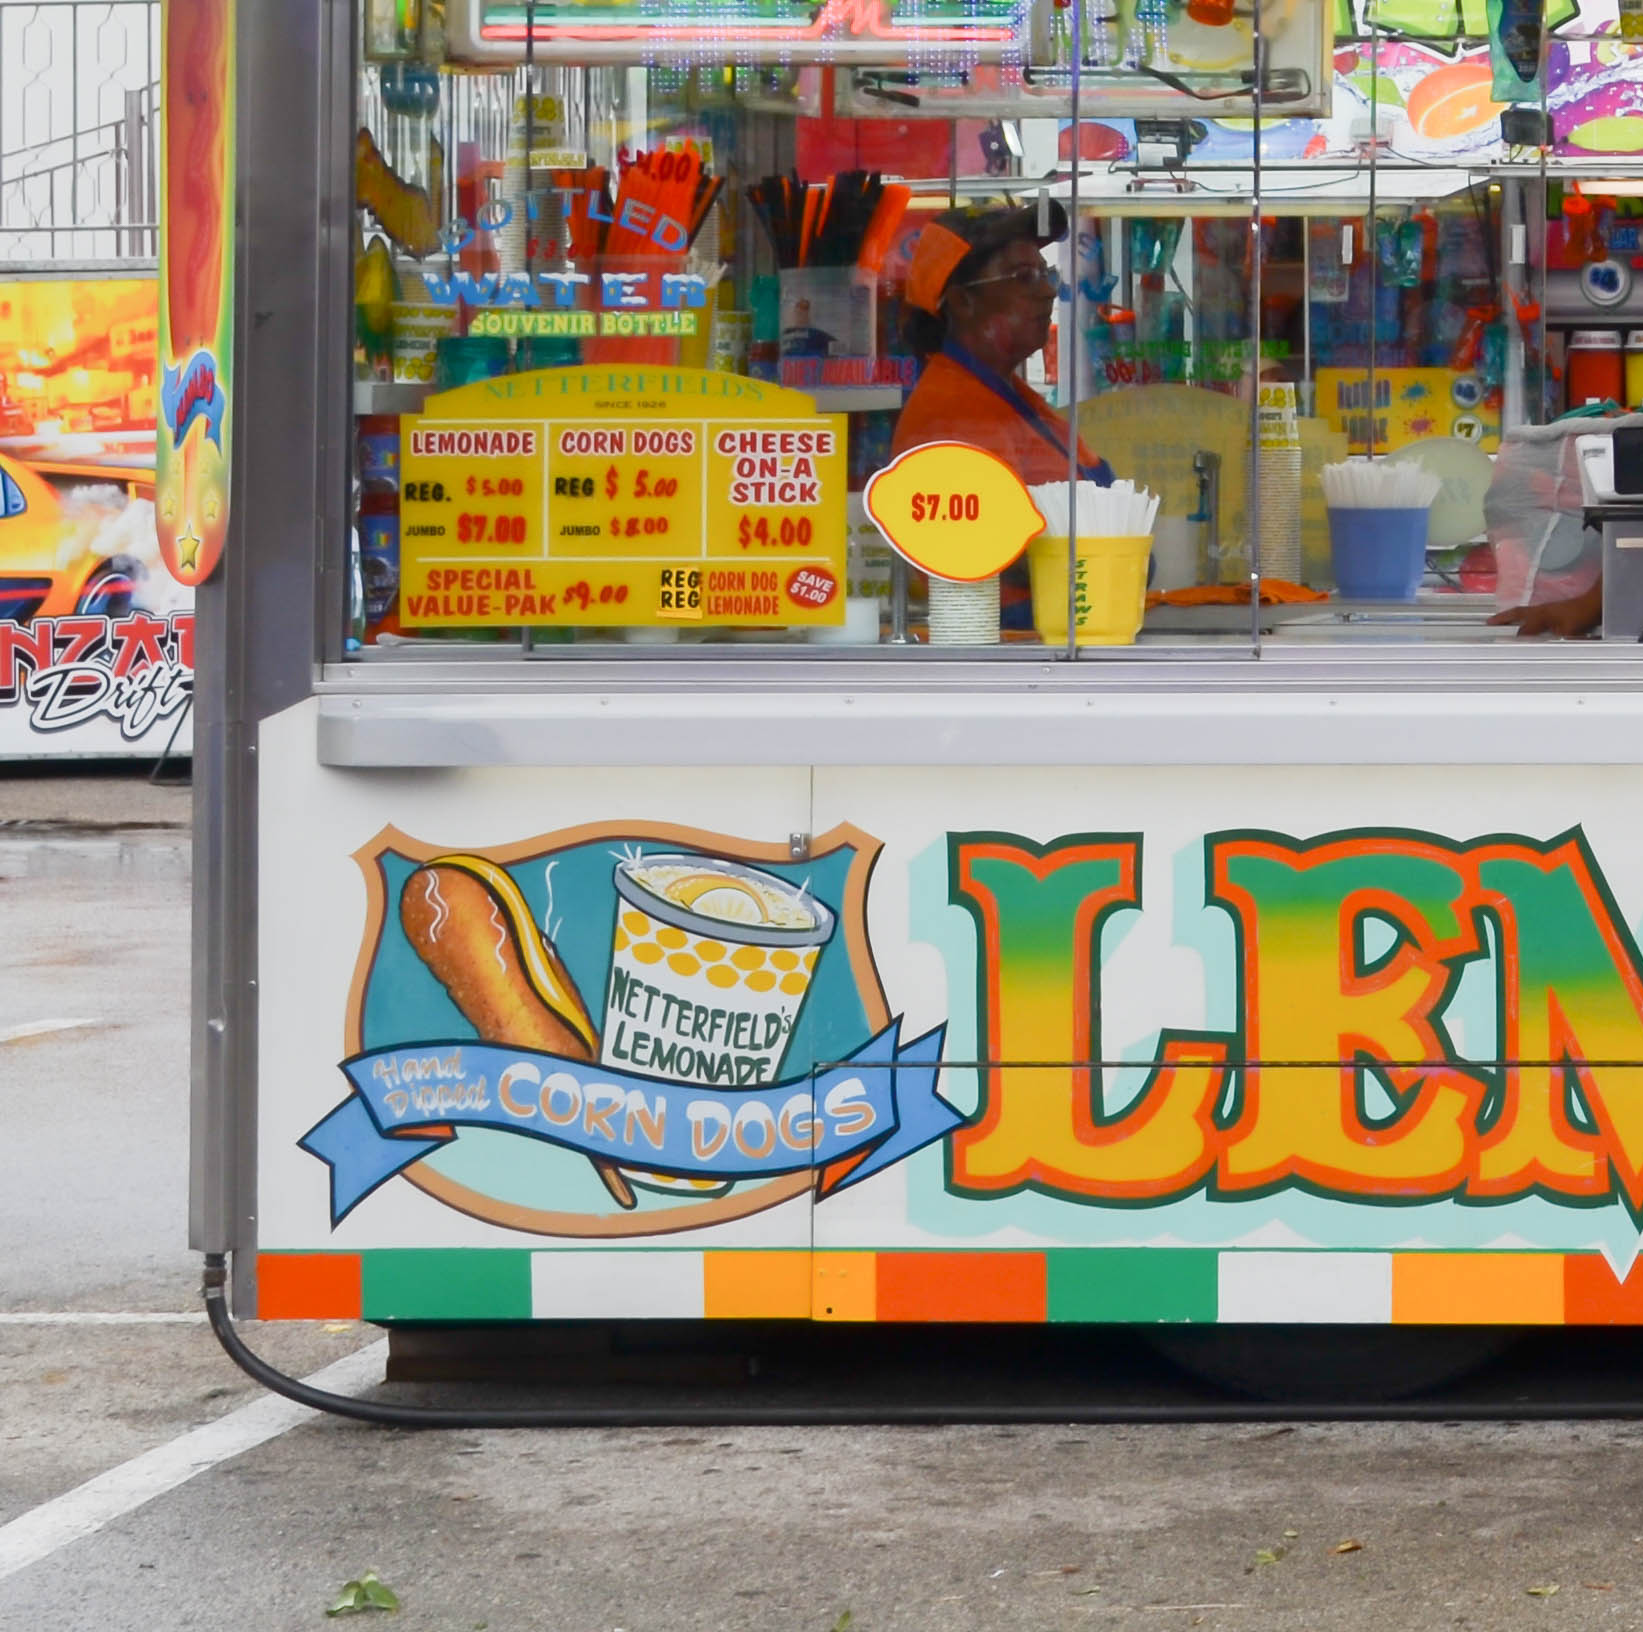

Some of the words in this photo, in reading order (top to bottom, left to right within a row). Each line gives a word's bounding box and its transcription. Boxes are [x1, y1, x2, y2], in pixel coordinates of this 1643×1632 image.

[437, 187, 688, 255] BOTTLED
[422, 271, 708, 307] WATER
[468, 312, 596, 336] SOUVENIR
[600, 312, 697, 336] BOTTLE
[411, 431, 535, 455] LEMONADE
[560, 430, 627, 456] CORN
[633, 430, 695, 456] DOGS
[717, 430, 834, 455] CHEESE
[735, 456, 814, 480] ON-A
[404, 482, 452, 503] REG.
[555, 476, 594, 497] REG
[732, 480, 819, 504] STICK
[911, 491, 980, 522] $7.00
[405, 525, 445, 536] JUMBO
[457, 513, 527, 544] $7.00
[560, 525, 600, 536] JUMBO
[738, 514, 812, 550] $4.00
[426, 568, 537, 591] SPECIAL
[661, 569, 700, 589] REG
[709, 571, 746, 592] CORN
[751, 571, 778, 592] DOG
[797, 570, 835, 594] SAVE
[407, 594, 556, 618] VALUE-PAK
[562, 580, 629, 610] $9.00
[661, 590, 700, 609] REG
[707, 595, 780, 617] LEMONADE
[789, 582, 827, 605] $1.00
[31, 664, 193, 732] Drift
[610, 966, 794, 1048] NETTERFIELD'S
[373, 1047, 467, 1089] Hand
[612, 1030, 773, 1087] LEMONADE
[383, 1074, 492, 1119] Dipped
[499, 1061, 667, 1150] CORN
[685, 1078, 877, 1158] DOGS
